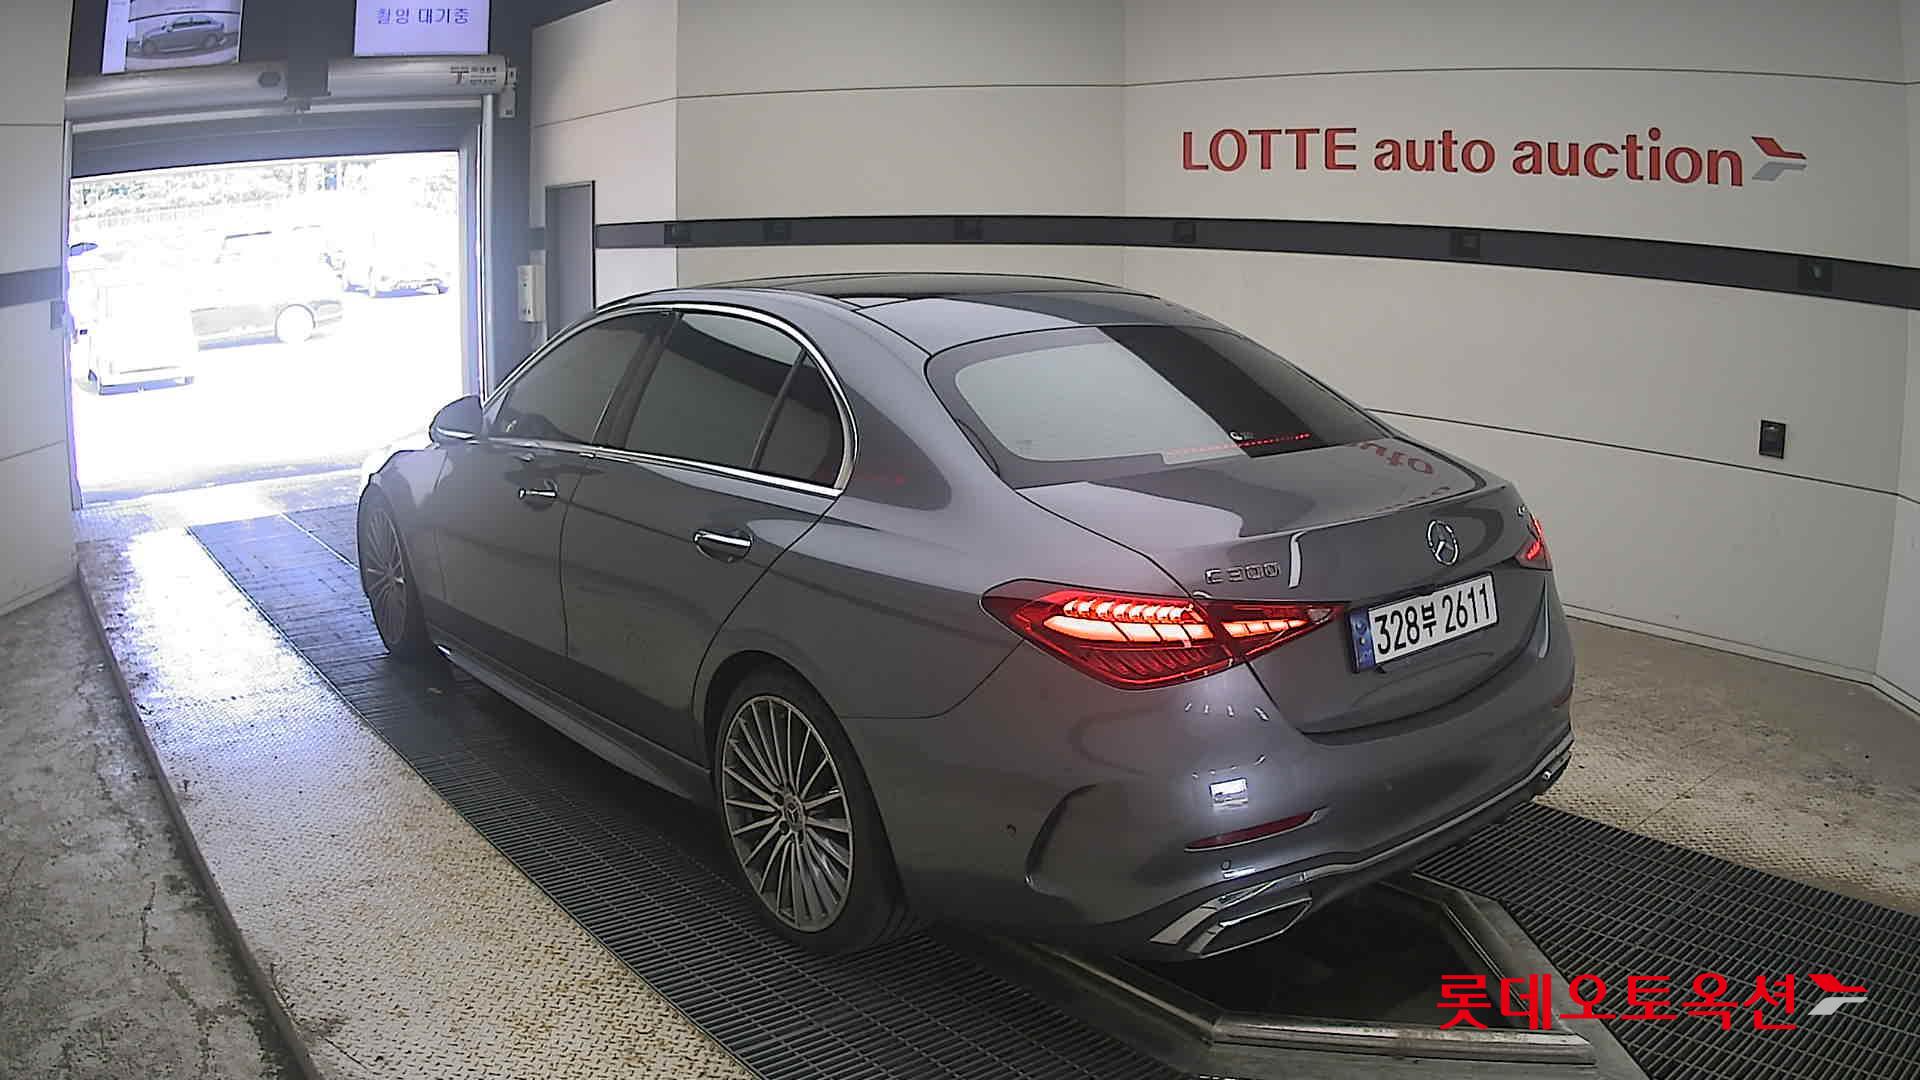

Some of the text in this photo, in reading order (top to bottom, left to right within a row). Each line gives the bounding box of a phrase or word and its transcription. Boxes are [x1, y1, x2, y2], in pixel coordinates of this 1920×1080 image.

[418, 7, 468, 24] 대기중
[1182, 127, 1744, 187] LOTTE auto auction
[1374, 584, 1490, 655] 328부 2611
